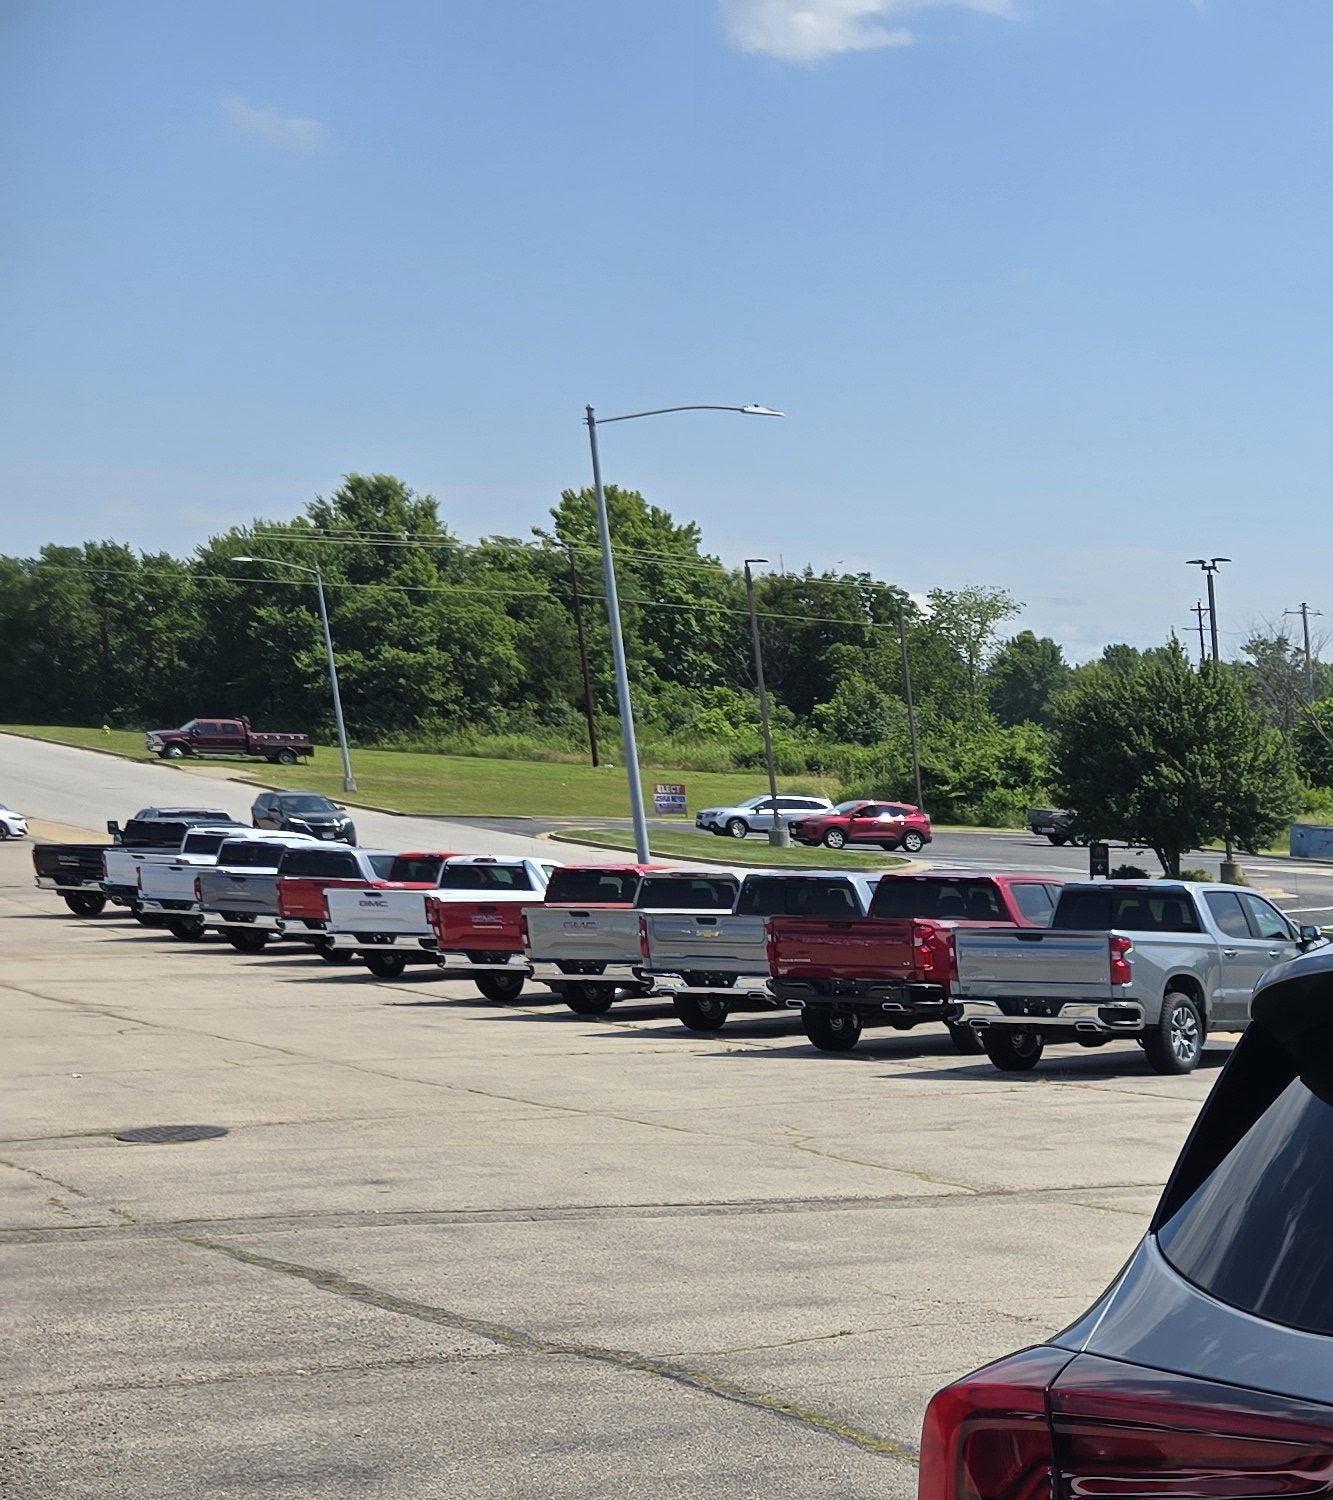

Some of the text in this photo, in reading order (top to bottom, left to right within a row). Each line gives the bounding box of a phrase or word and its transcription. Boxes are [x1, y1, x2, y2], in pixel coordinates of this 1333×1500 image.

[656, 784, 681, 794] ELECT
[359, 900, 389, 908] GMC
[563, 921, 597, 929] GMC
